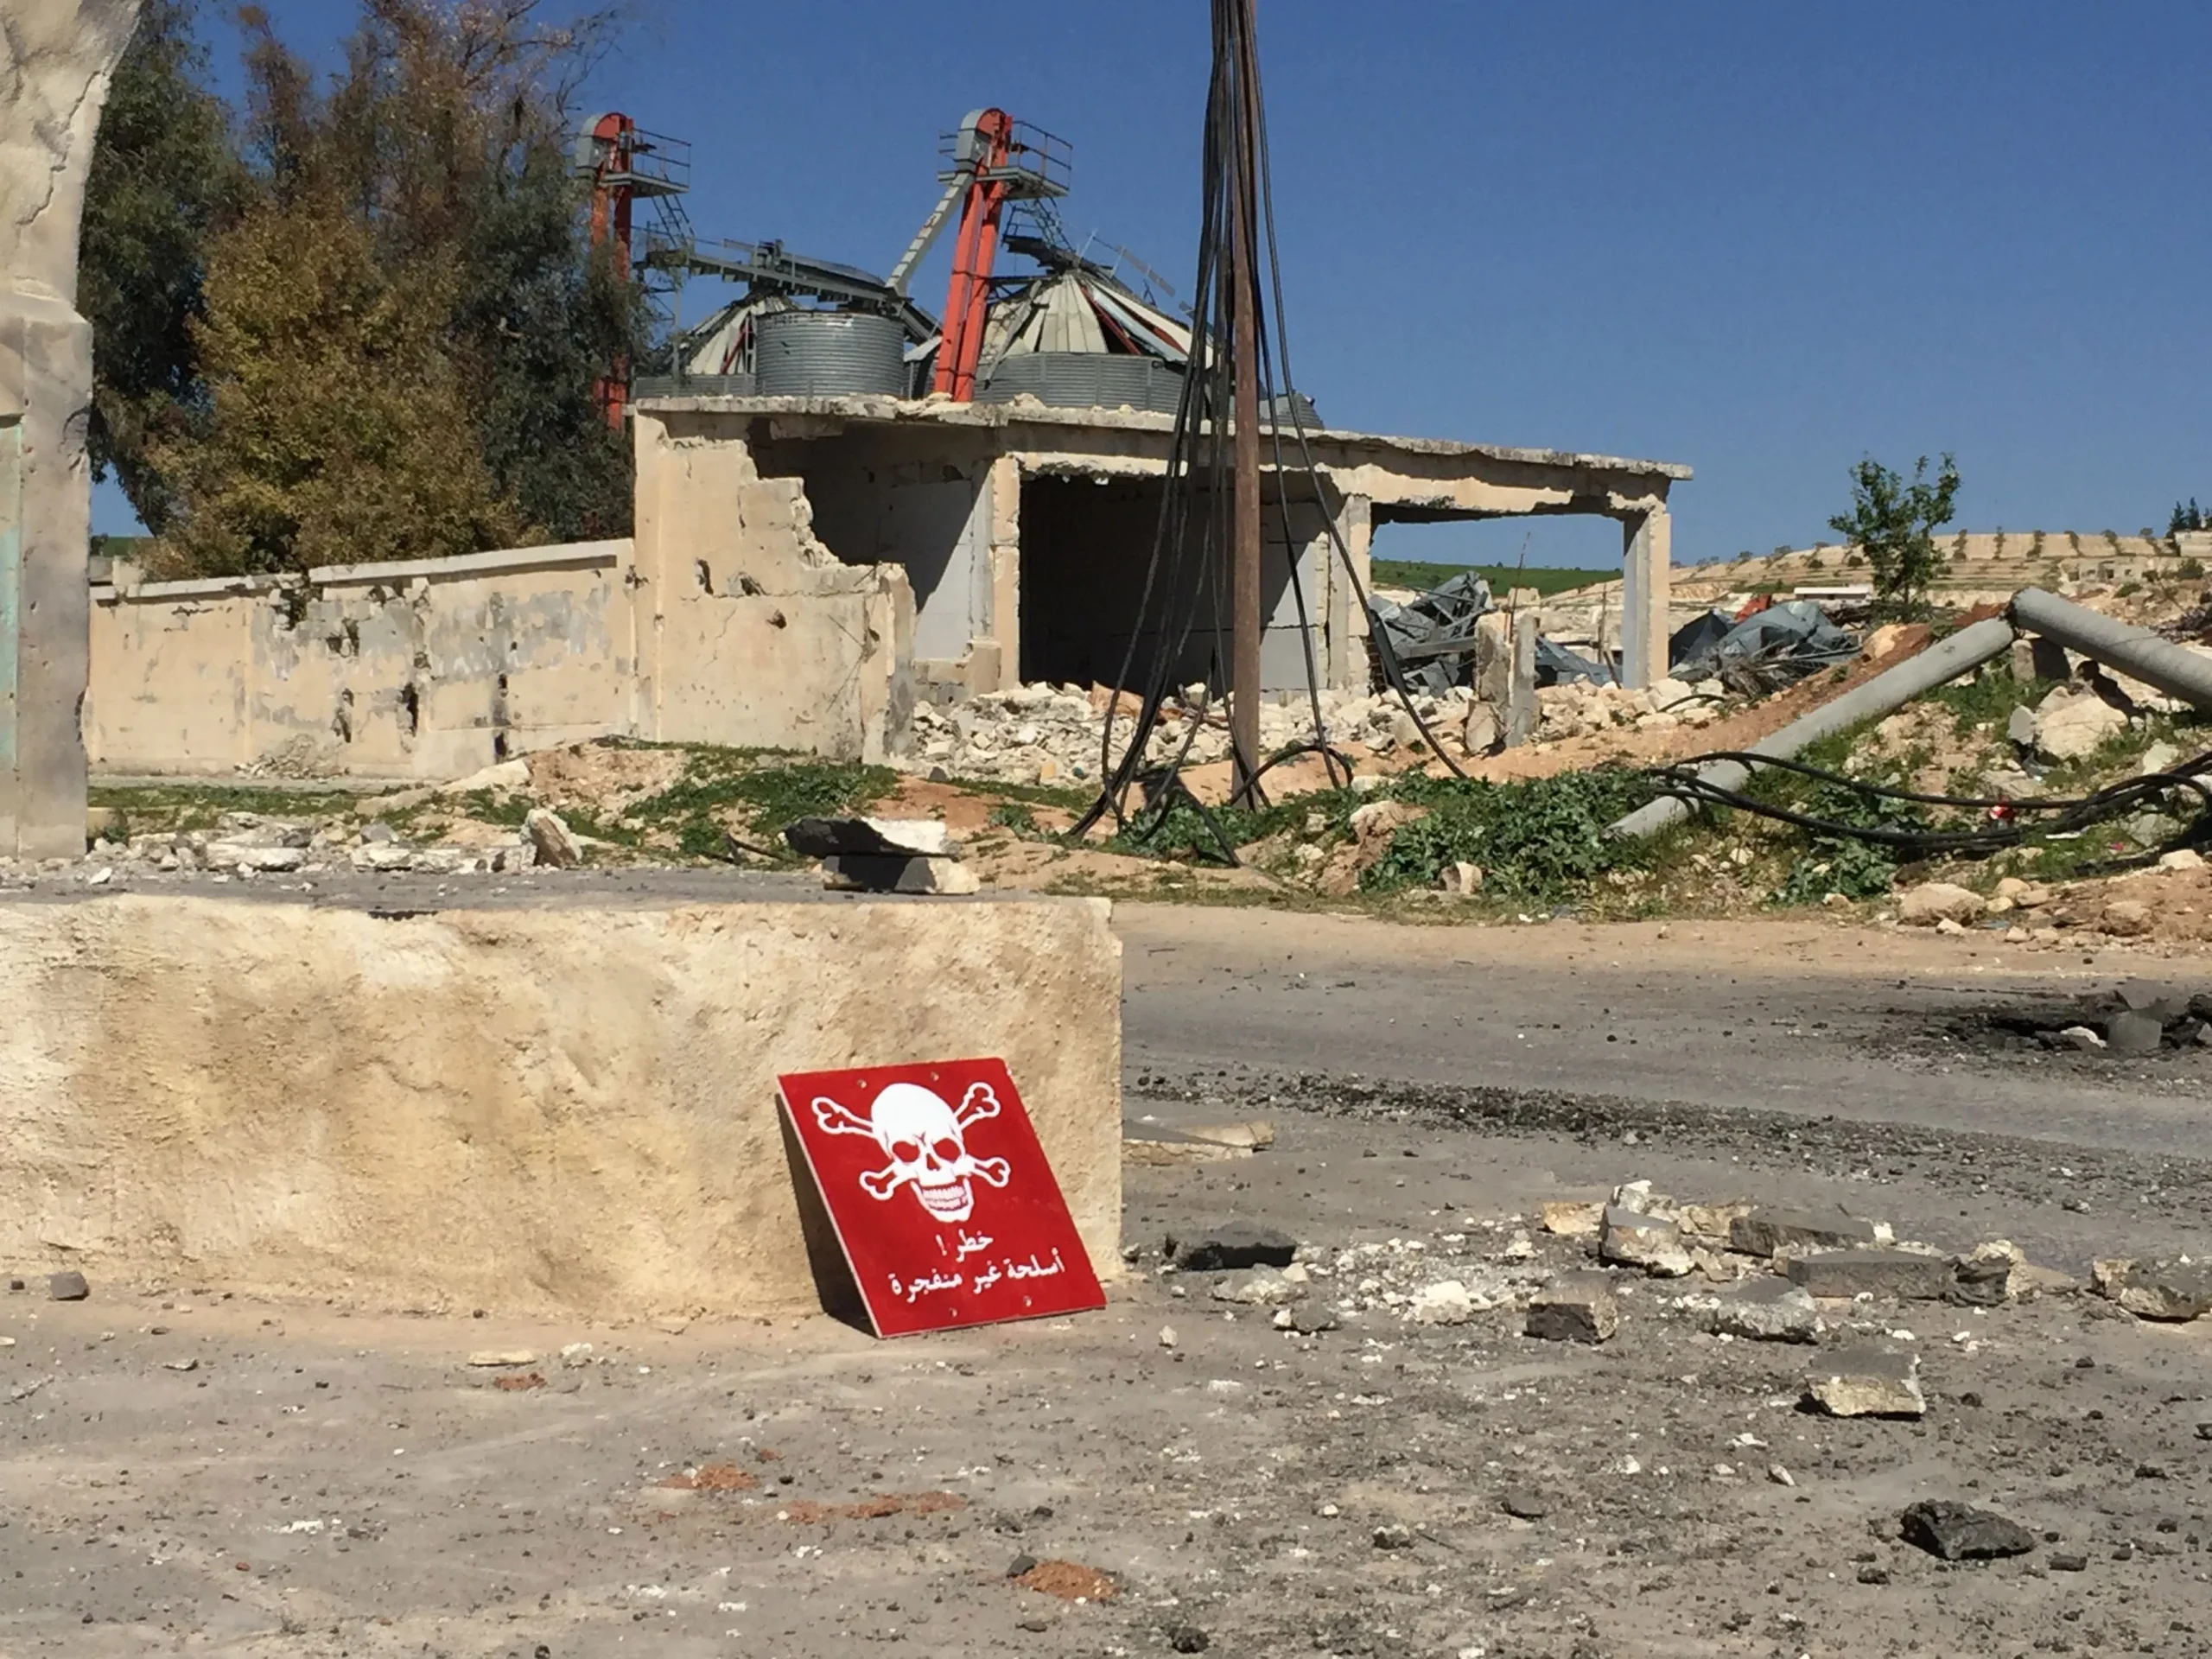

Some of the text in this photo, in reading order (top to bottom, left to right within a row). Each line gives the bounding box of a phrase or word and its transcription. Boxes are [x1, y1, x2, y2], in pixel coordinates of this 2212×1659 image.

[957, 1229, 994, 1262] خطر
[888, 1248, 1065, 1303] أسلحة غير منفجرة
